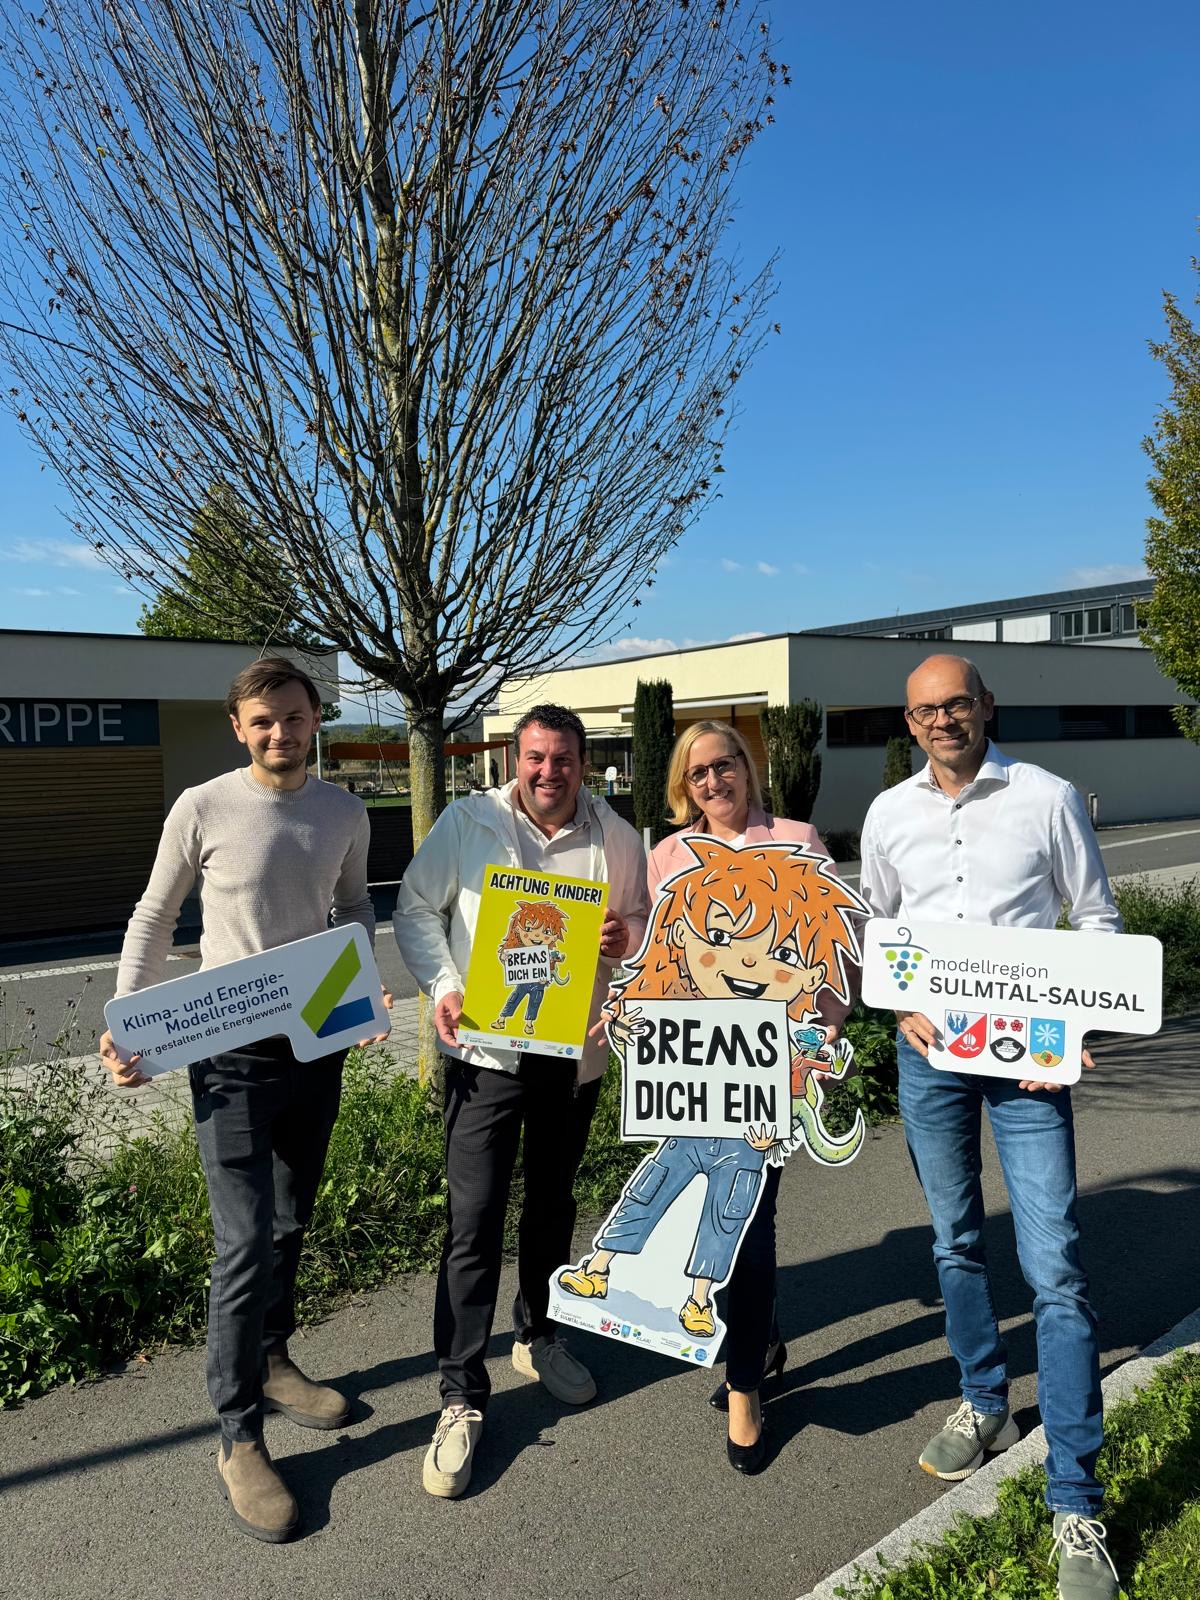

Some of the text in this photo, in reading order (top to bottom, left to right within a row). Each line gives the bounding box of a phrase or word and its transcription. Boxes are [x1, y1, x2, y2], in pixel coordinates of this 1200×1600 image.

[490, 873, 603, 906] ACHTUNG KINDER!
[507, 950, 547, 967] BREMS
[508, 967, 548, 981] DICH EIN
[930, 957, 1049, 980] modellregion
[122, 972, 285, 1032] Klima- und Energie-
[165, 986, 289, 1034] Modellregionen
[929, 976, 1145, 1012] SULMTAL-SAUSAL
[133, 1001, 293, 1060] Wir gestalten die Energiewende
[637, 1018, 778, 1068] BREMS
[635, 1080, 776, 1123] DICH EIN
